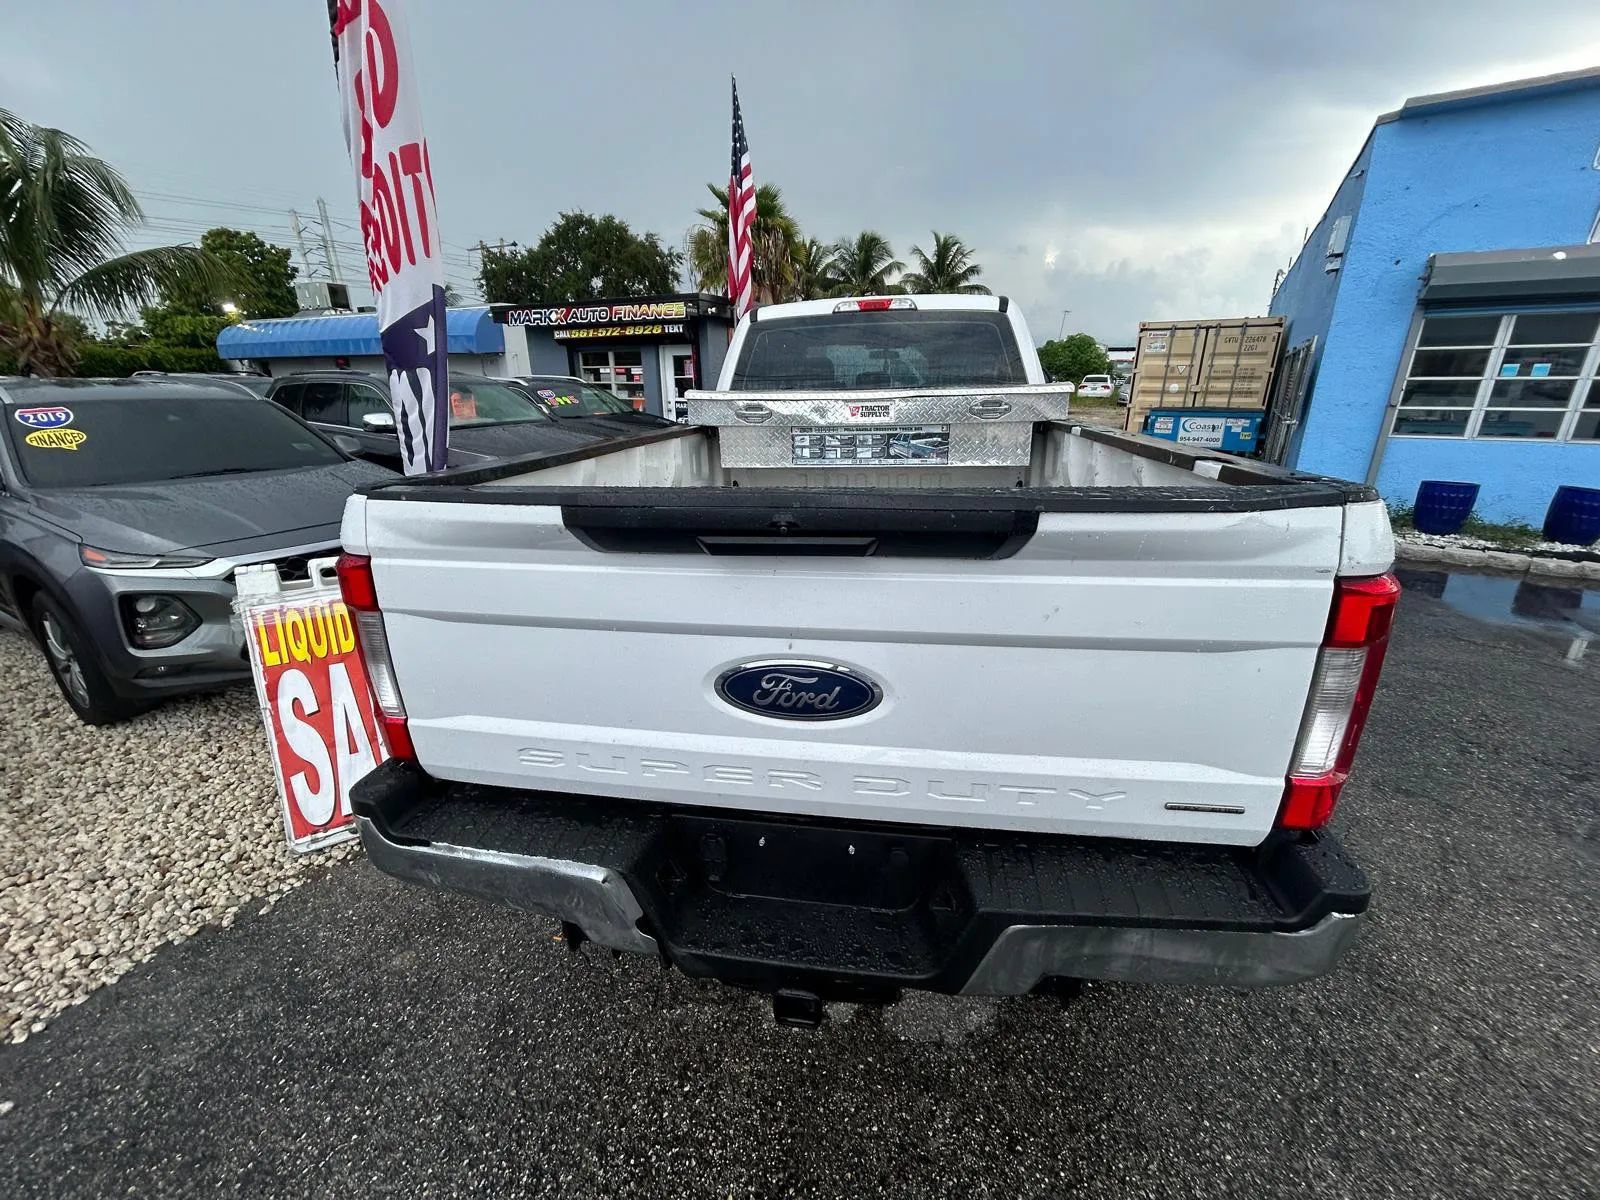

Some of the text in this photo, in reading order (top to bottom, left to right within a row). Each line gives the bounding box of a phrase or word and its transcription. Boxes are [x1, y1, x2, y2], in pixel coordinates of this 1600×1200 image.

[567, 307, 609, 322] AUTO
[612, 302, 686, 321] FINANCE
[554, 330, 570, 338] CALL
[664, 324, 684, 333] TEXT
[24, 411, 67, 423] 2019
[28, 432, 84, 447] FINANCED
[257, 602, 356, 667] LIQUID
[752, 672, 842, 710] Ford
[517, 747, 1127, 810] SUPER DUTY
